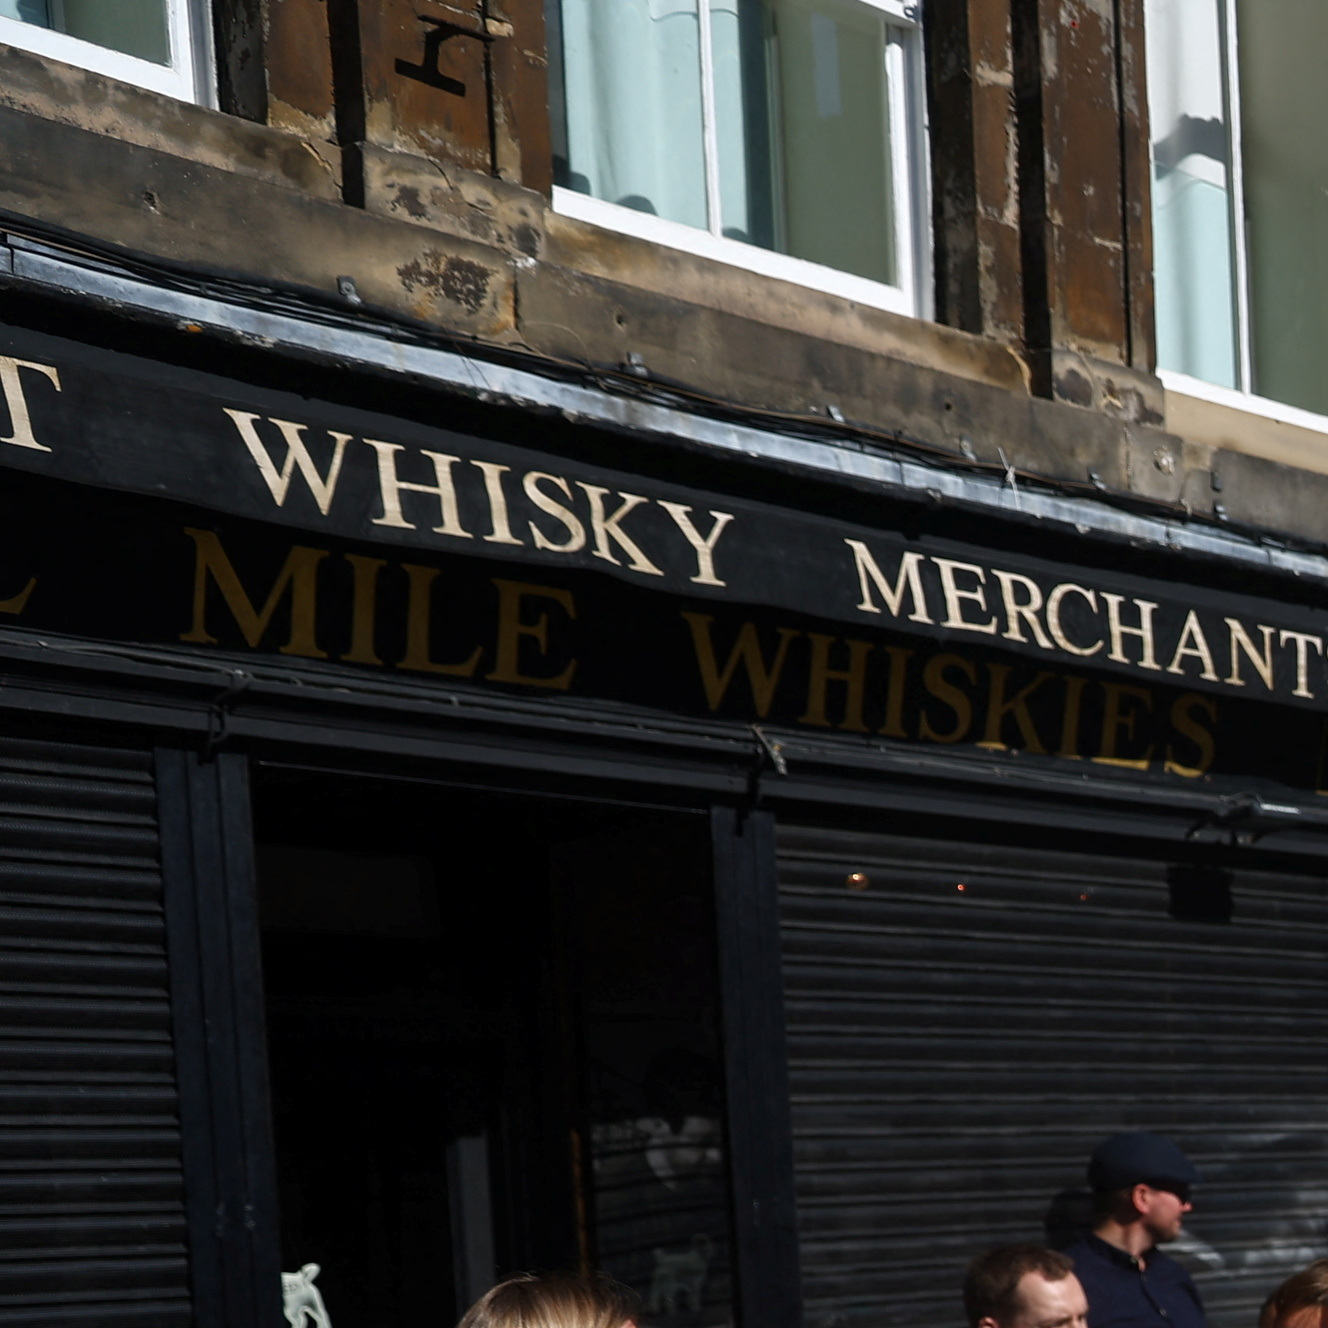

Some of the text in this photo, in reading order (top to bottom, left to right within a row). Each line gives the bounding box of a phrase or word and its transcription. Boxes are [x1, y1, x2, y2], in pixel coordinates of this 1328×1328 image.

[223, 408, 734, 587] WHISKY
[180, 526, 1222, 779] MILE WHISKIES
